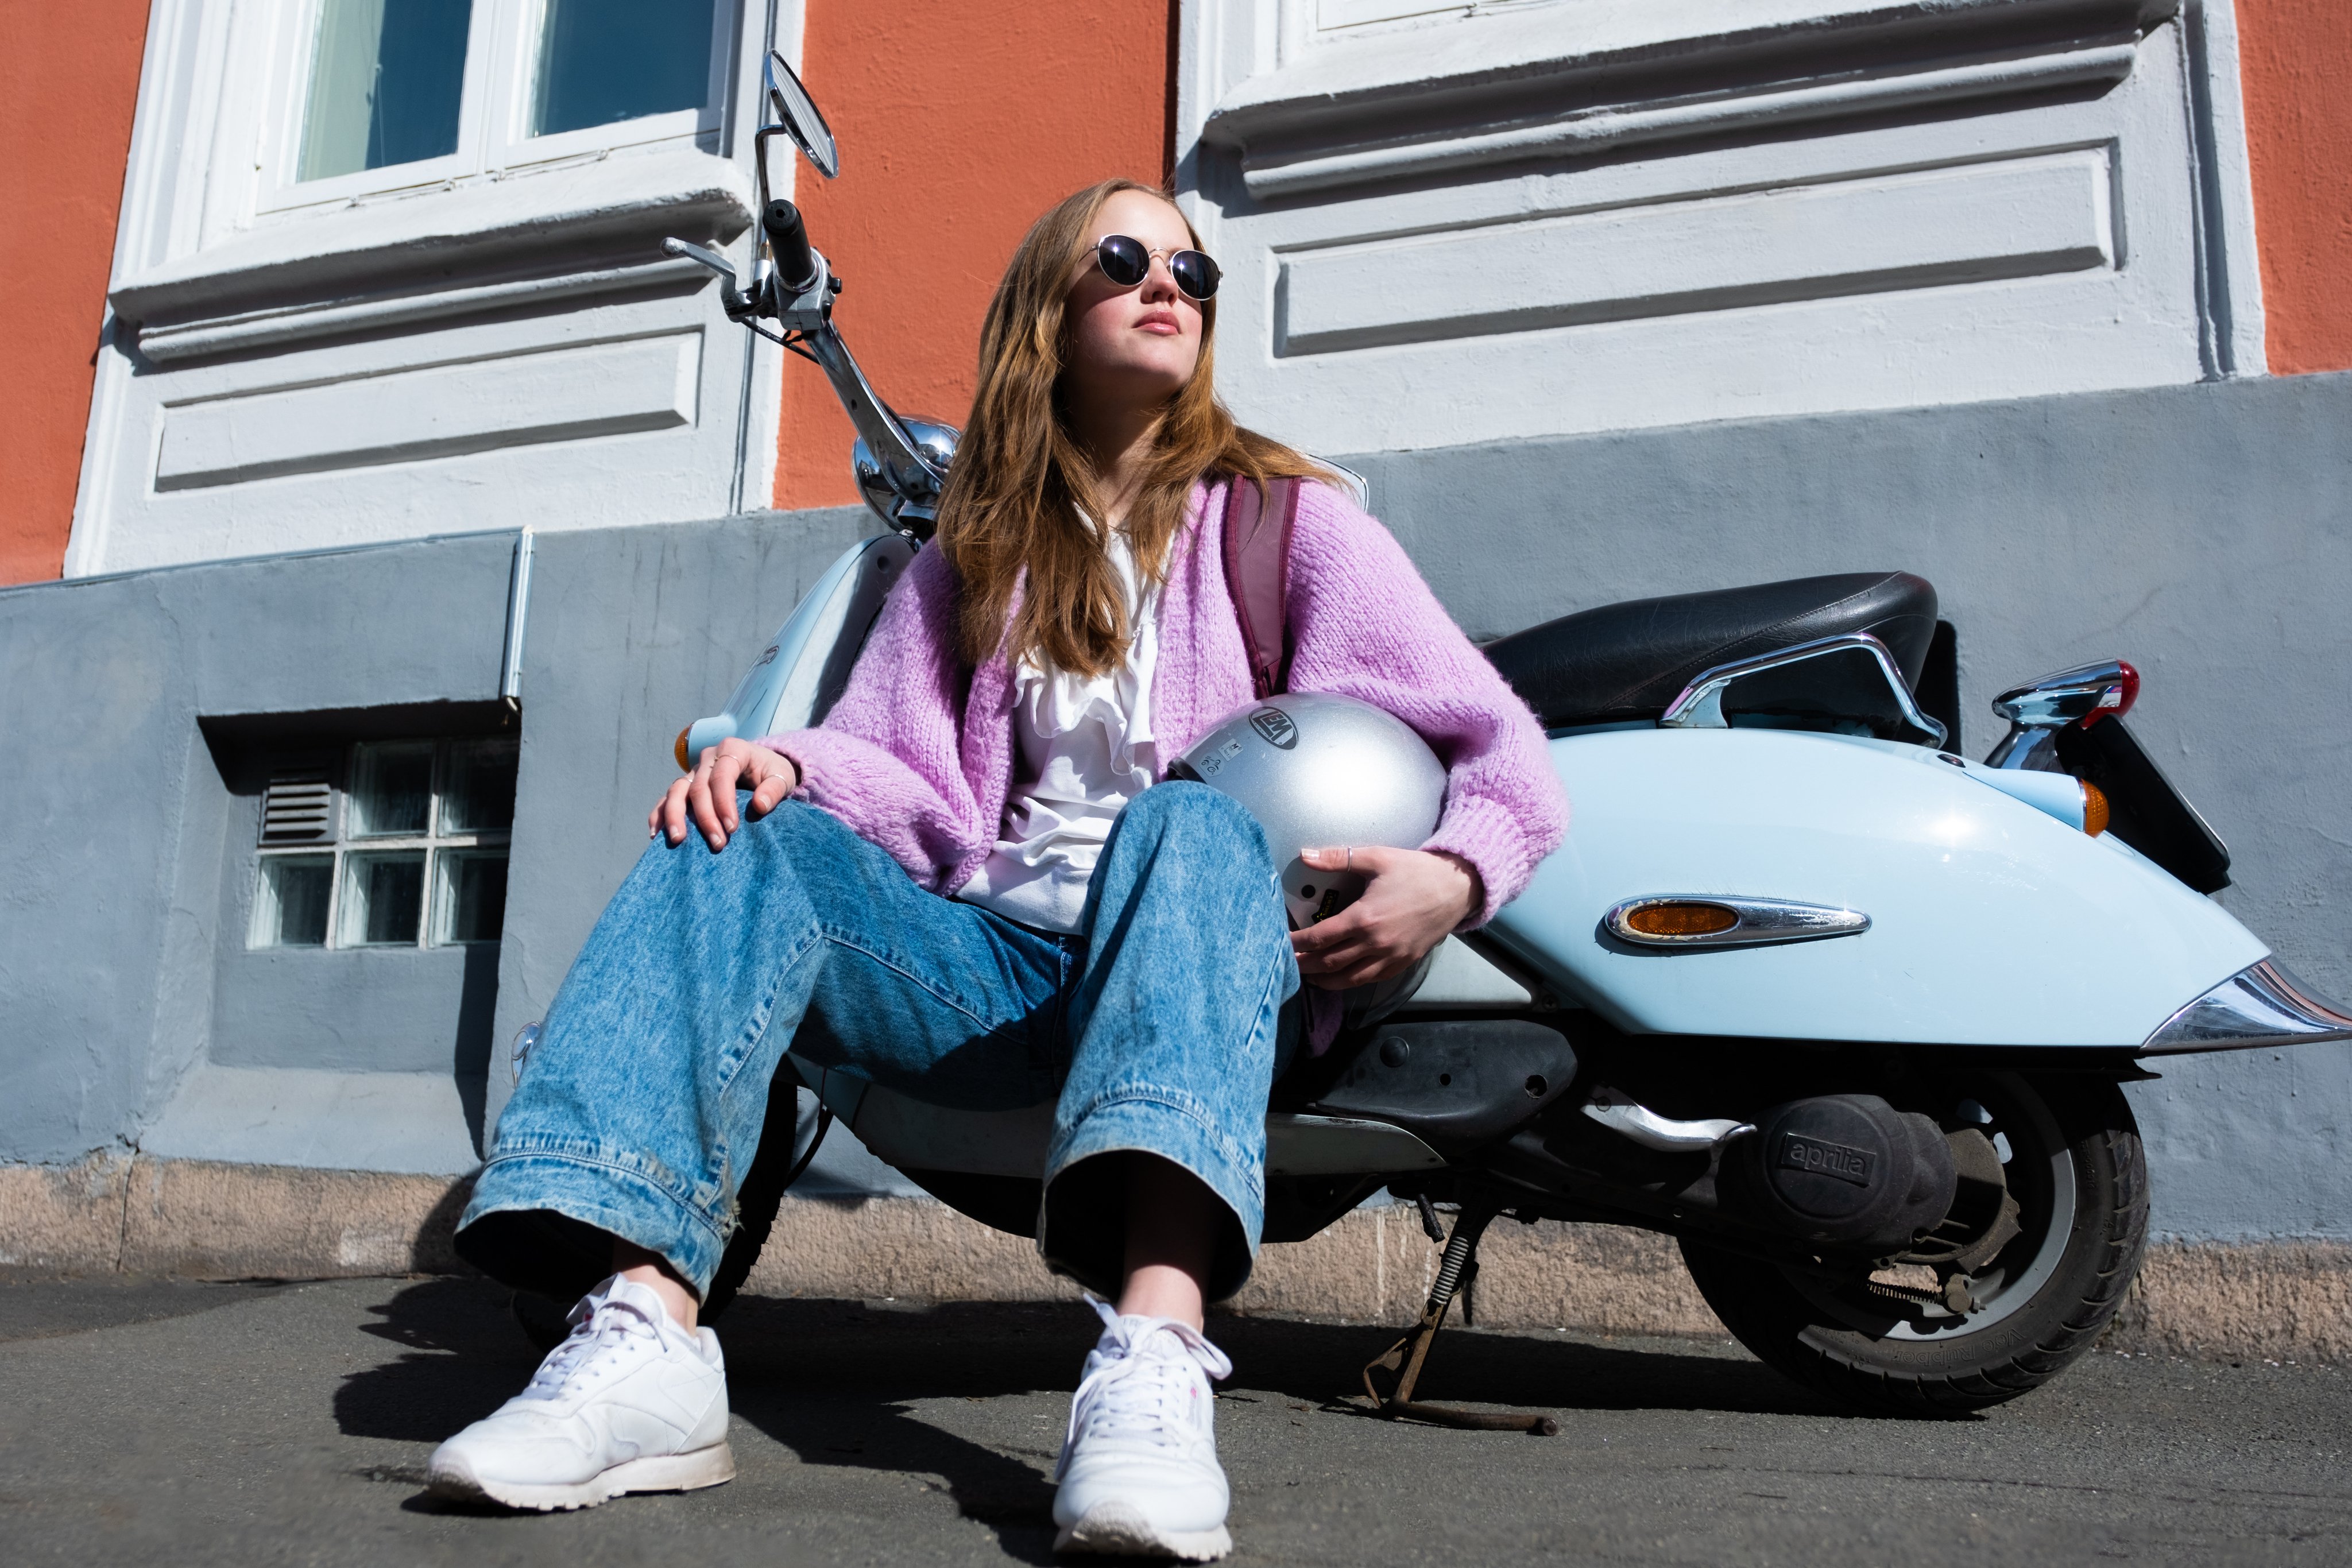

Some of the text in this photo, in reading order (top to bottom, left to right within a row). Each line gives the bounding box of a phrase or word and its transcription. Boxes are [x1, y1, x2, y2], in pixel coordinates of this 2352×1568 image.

[1252, 711, 1293, 742] LEM
[1790, 1143, 1864, 1176] aprilia
[1891, 1345, 1975, 1366] Rubber
